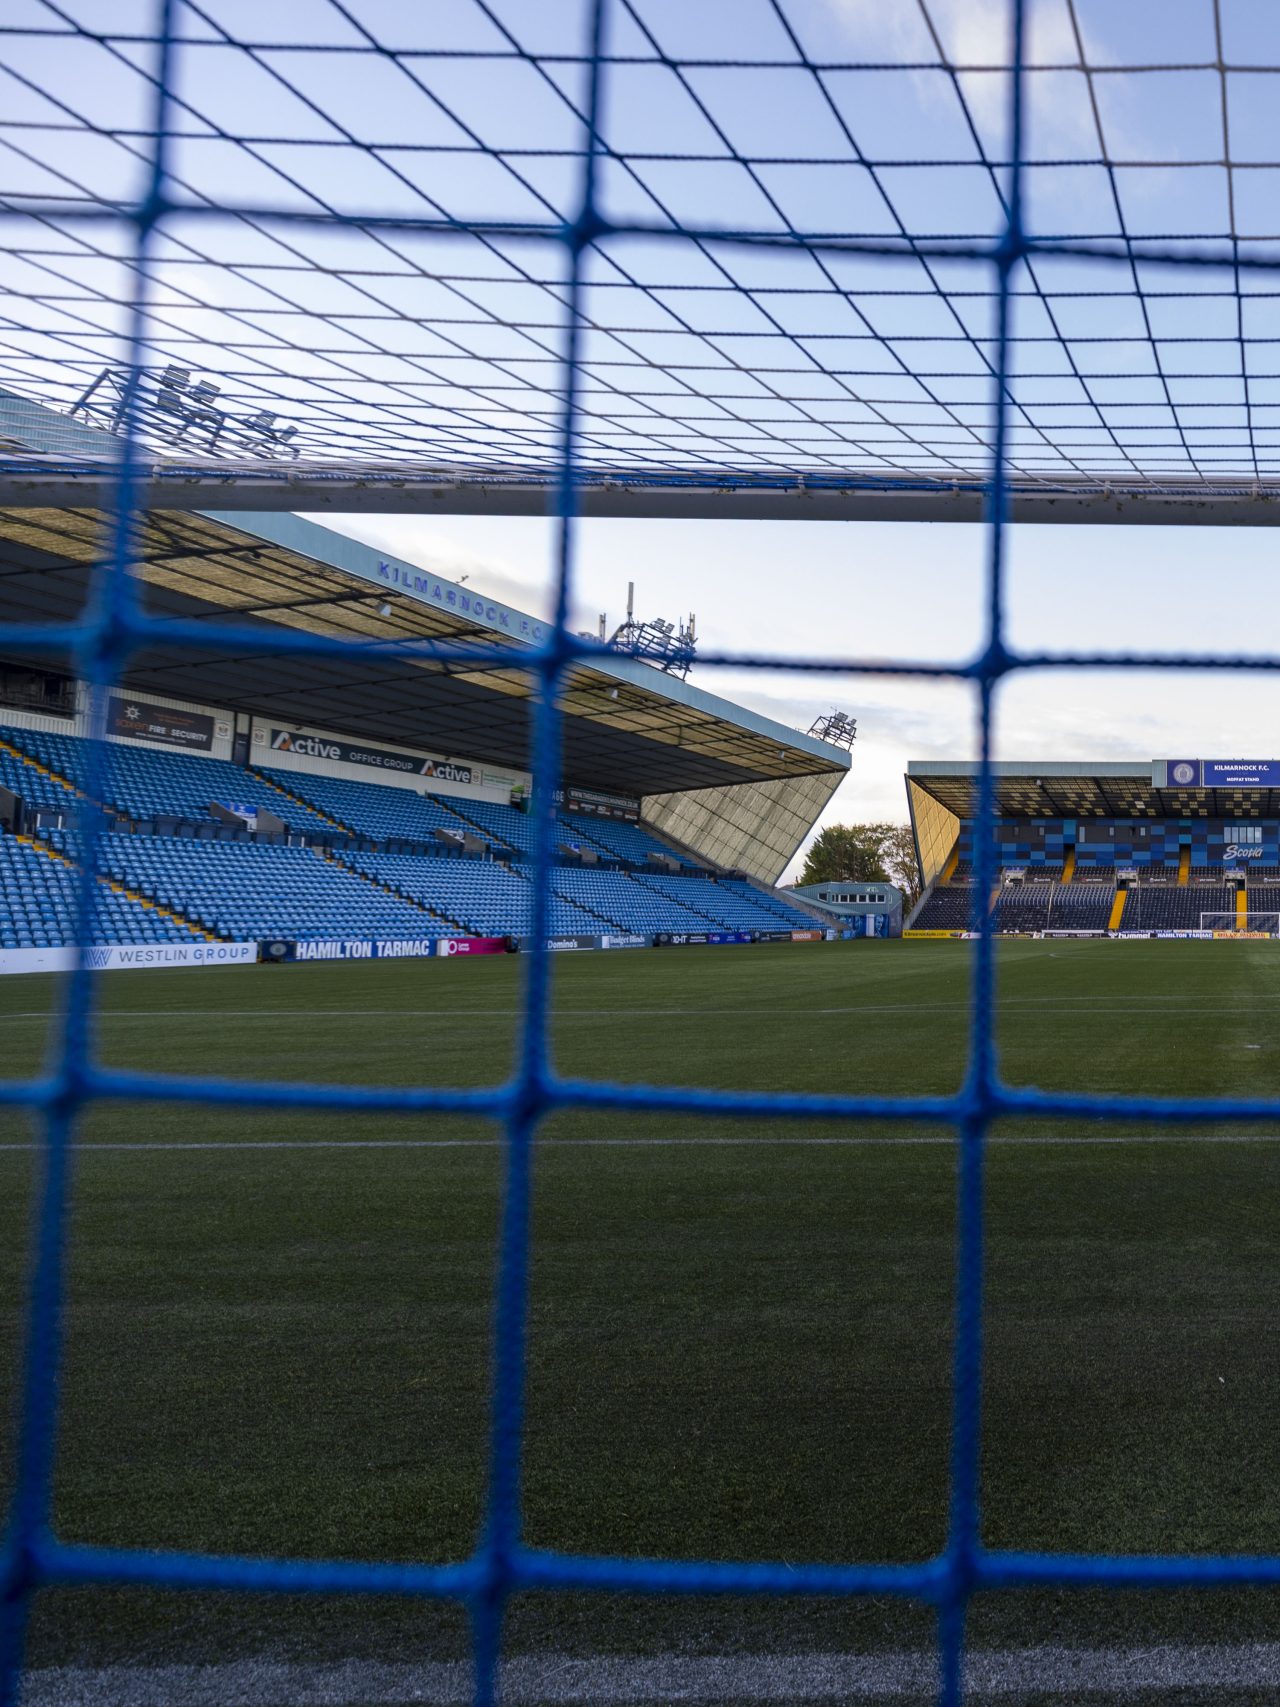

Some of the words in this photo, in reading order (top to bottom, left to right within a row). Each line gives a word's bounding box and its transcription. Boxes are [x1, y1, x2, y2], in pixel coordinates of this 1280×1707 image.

[378, 561, 509, 627] KILMARNOCK
[149, 724, 167, 735] FIRE
[171, 728, 208, 742] SECURITY
[271, 731, 341, 760] Active
[349, 752, 382, 765] OFFICE
[384, 758, 414, 770] GROUP
[420, 760, 471, 783] Active
[548, 939, 578, 948] Domino's
[609, 936, 629, 945] Budget
[630, 935, 645, 943] Blinds
[119, 949, 187, 962] WESTLIN
[194, 947, 249, 960] GROUP
[296, 940, 372, 959] HAMILTON
[376, 940, 429, 957] TARMAC
